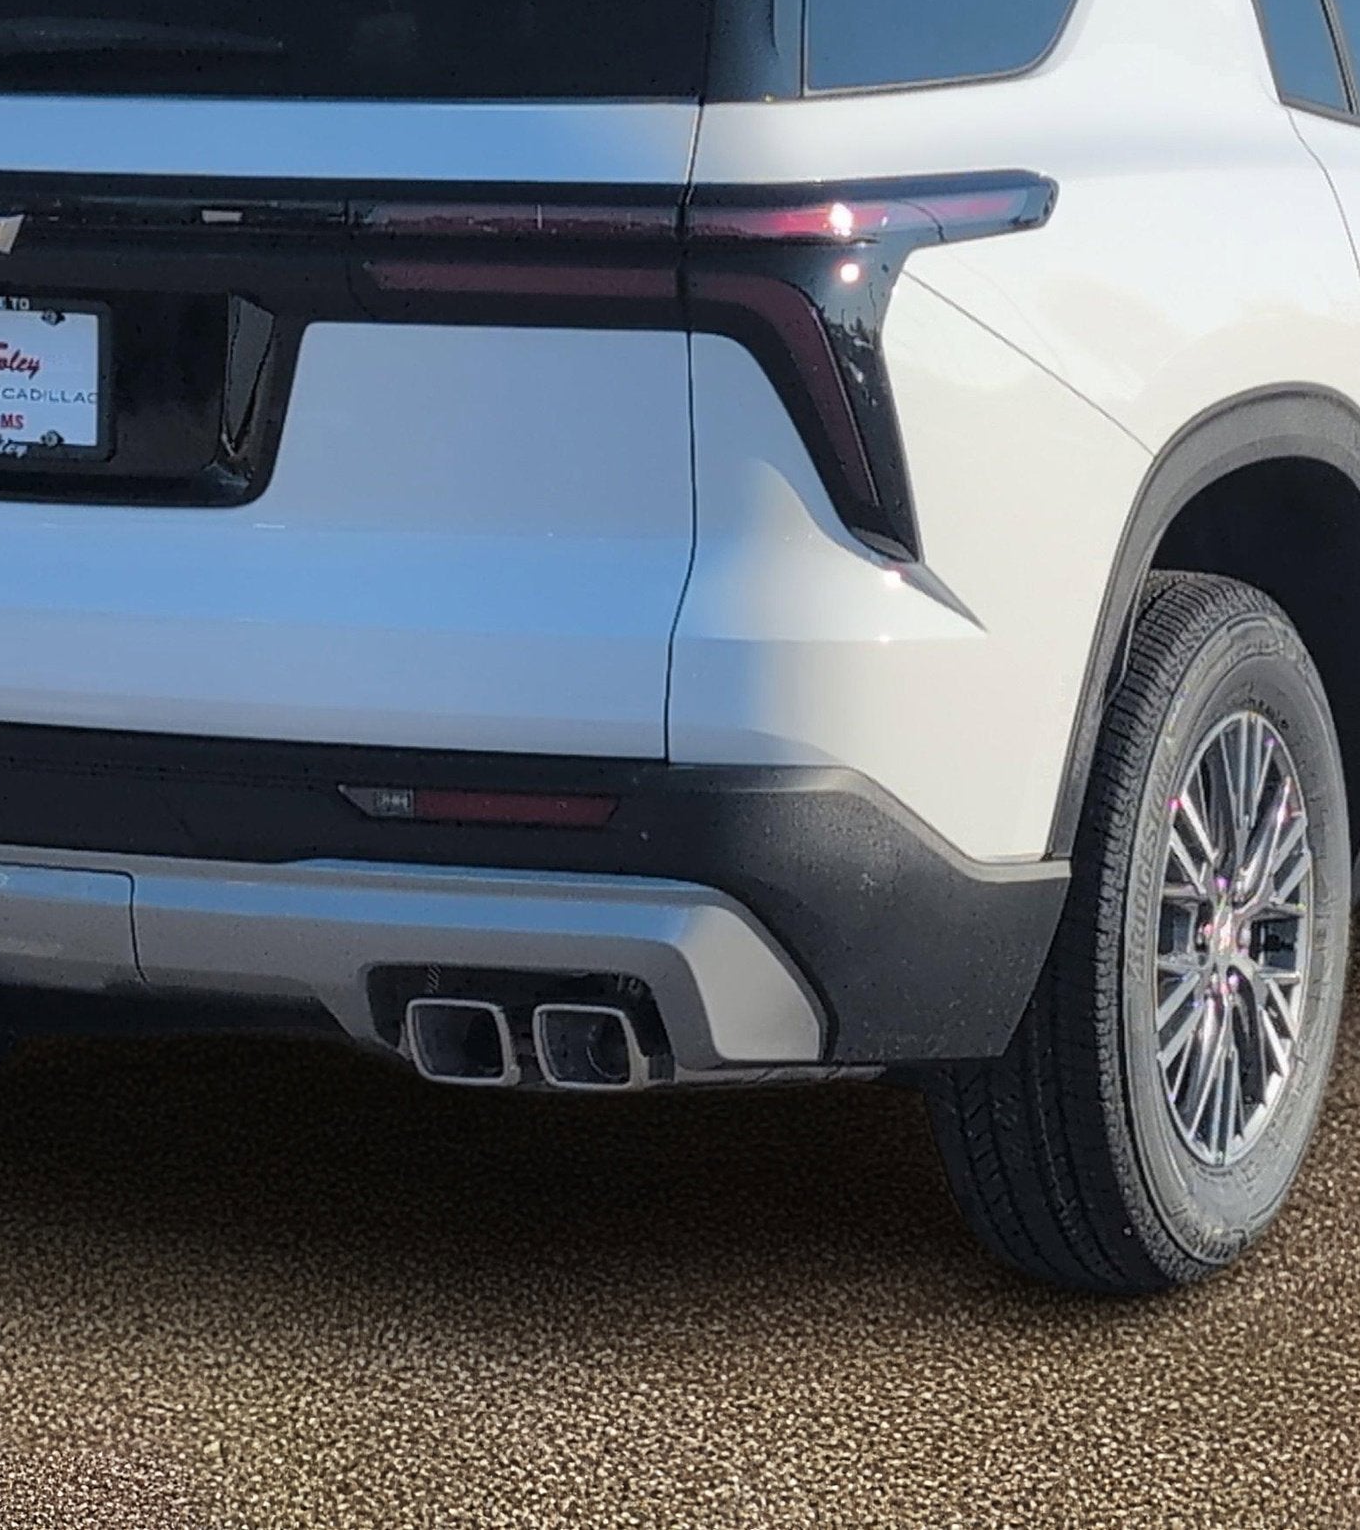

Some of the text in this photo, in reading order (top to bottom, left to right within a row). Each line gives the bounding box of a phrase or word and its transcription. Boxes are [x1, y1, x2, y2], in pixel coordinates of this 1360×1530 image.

[10, 297, 31, 311] TO
[1, 388, 98, 404] CADILLAC
[0, 413, 24, 430] MS
